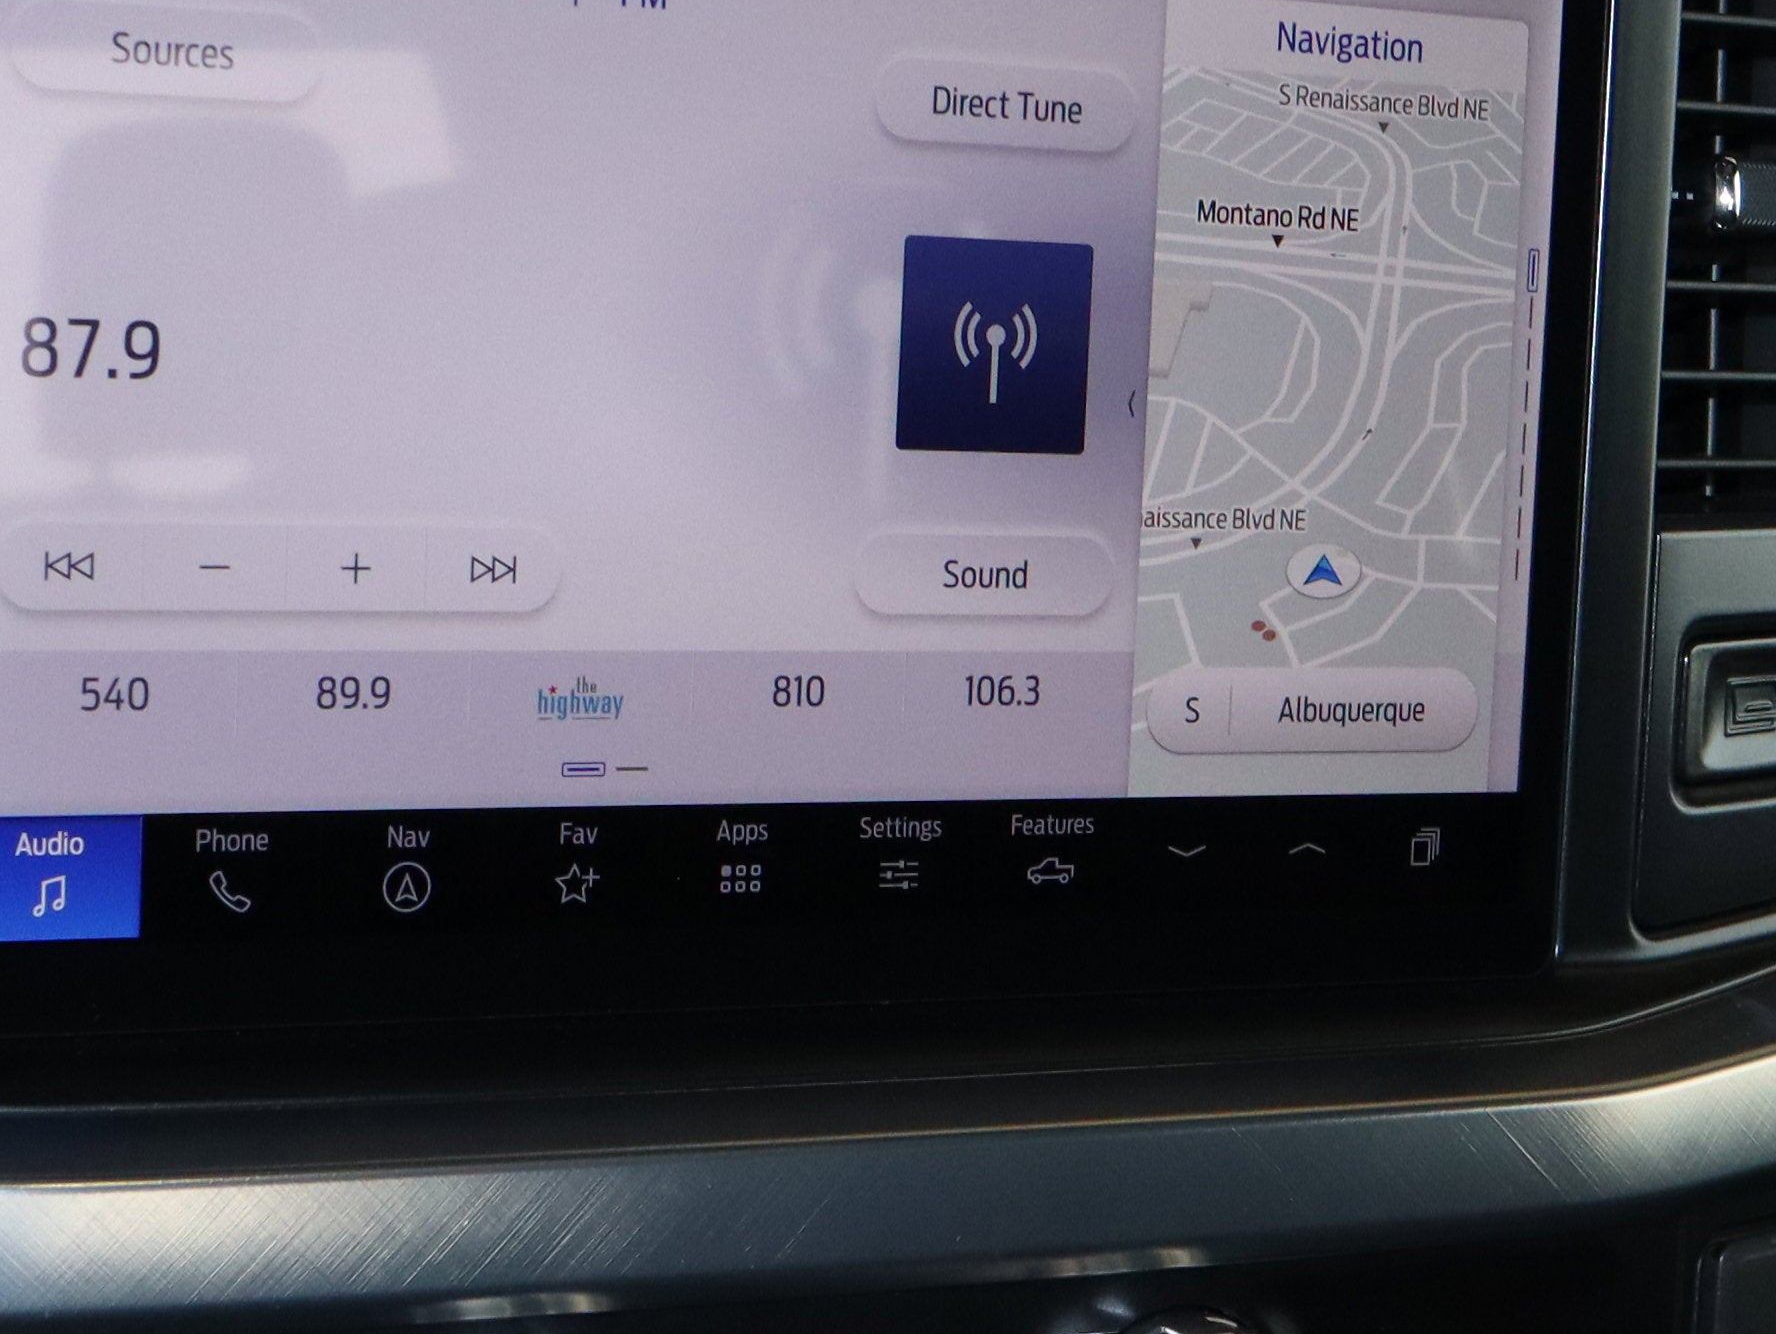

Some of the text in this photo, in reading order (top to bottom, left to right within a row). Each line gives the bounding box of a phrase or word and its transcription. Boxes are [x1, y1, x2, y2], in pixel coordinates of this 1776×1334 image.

[111, 32, 234, 70] Sources
[1277, 21, 1424, 63] Navigation
[932, 86, 1083, 125] Direct Tune
[1279, 84, 1489, 120] S Renaissance Blvd NE
[1197, 199, 1359, 232] Montano Rd NE
[21, 317, 161, 380] 87.9
[1141, 506, 1306, 531] aissance Blvd NE
[942, 560, 1028, 590] Sound
[80, 677, 149, 711] 540
[316, 676, 391, 709] 89.9
[576, 676, 597, 694] the
[772, 675, 824, 707] 810
[965, 675, 1040, 707] 106.3
[537, 685, 624, 720] highway
[1186, 696, 1424, 727] S Albuquerque
[196, 828, 269, 853] Phone
[388, 825, 430, 848] Nav
[560, 822, 598, 846] Fav
[717, 819, 768, 844] Apps
[859, 816, 942, 842] Settings
[1011, 813, 1094, 837] Features
[15, 832, 84, 857] Audio
